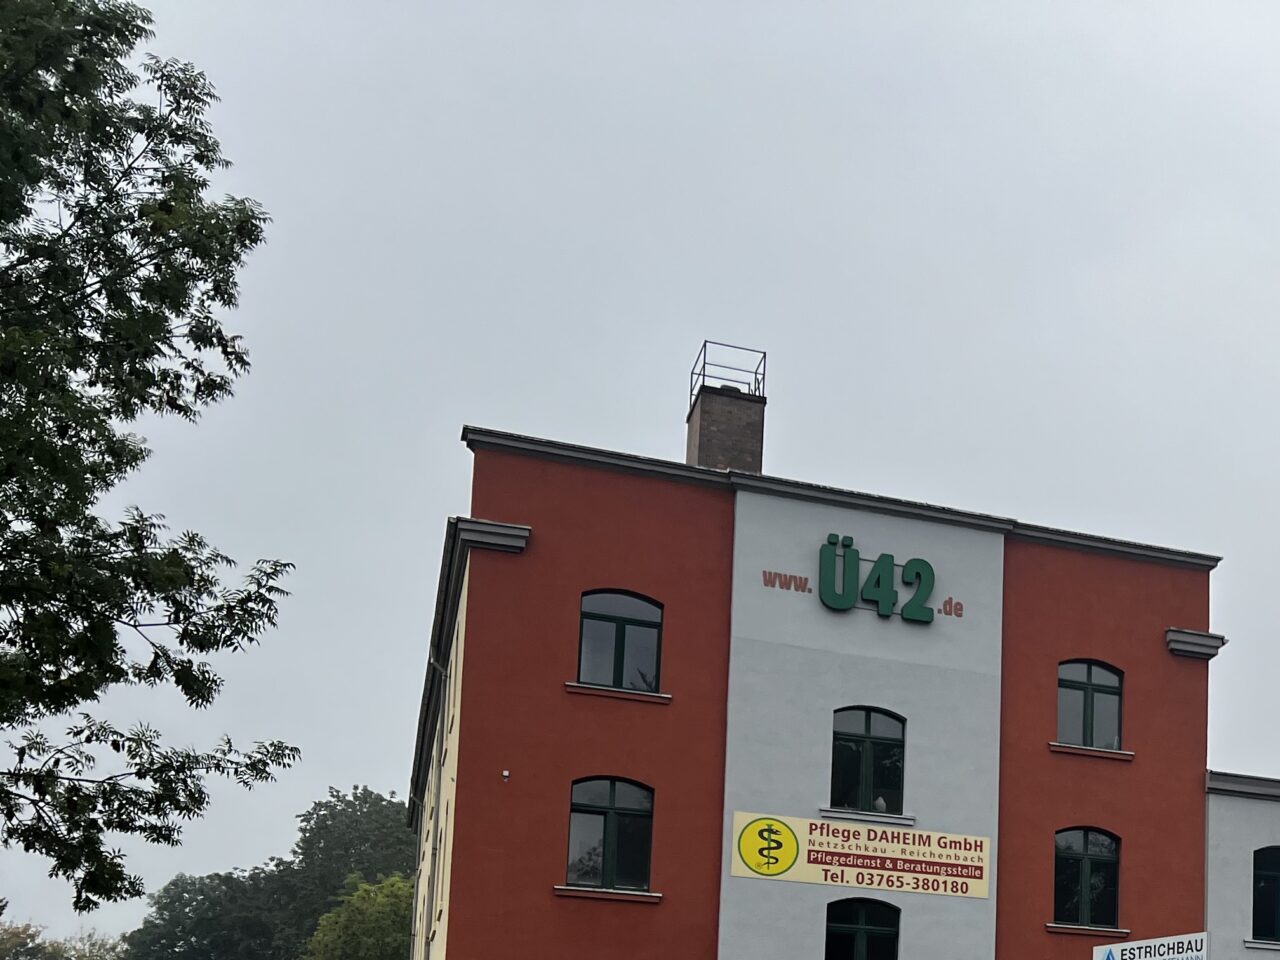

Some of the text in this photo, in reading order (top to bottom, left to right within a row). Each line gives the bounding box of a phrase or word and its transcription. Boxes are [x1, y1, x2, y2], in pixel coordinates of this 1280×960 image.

[808, 822, 984, 852] Pflege DAHEIM GmbH
[808, 839, 887, 854] Netzschkau
[900, 848, 984, 863] Reichenbach
[810, 853, 982, 877] Pflegedienst & Beratungsstelle
[822, 868, 969, 894] Tel. 03765-380180
